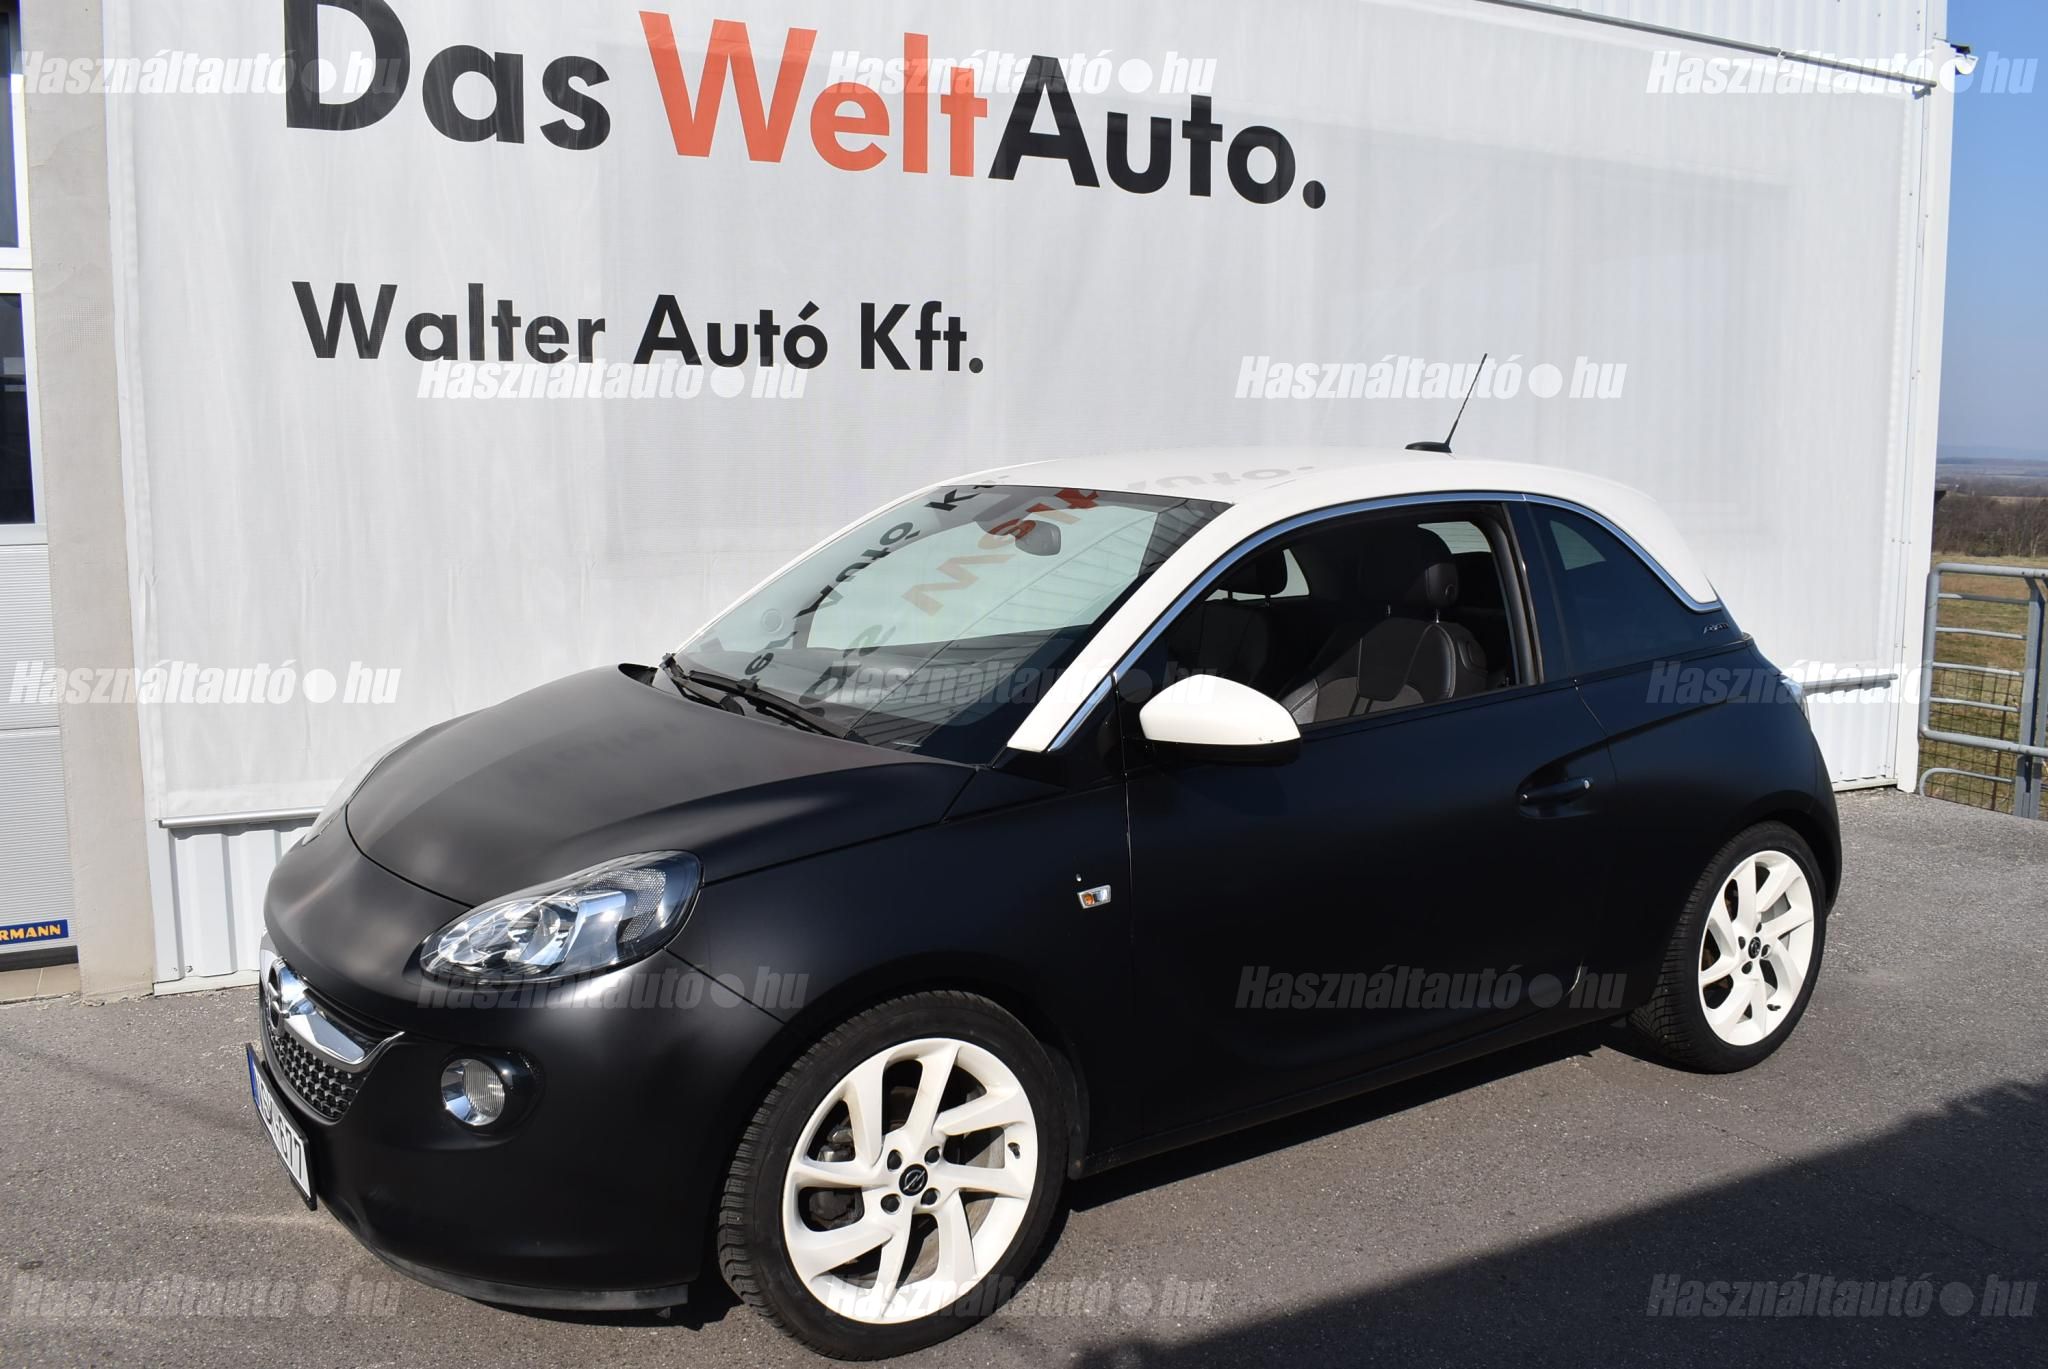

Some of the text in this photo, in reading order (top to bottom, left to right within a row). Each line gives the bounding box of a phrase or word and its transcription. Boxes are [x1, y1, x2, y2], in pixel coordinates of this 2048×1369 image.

[285, 0, 1326, 209] Das WeltAuto.
[292, 281, 983, 374] Walter Autó Kft.
